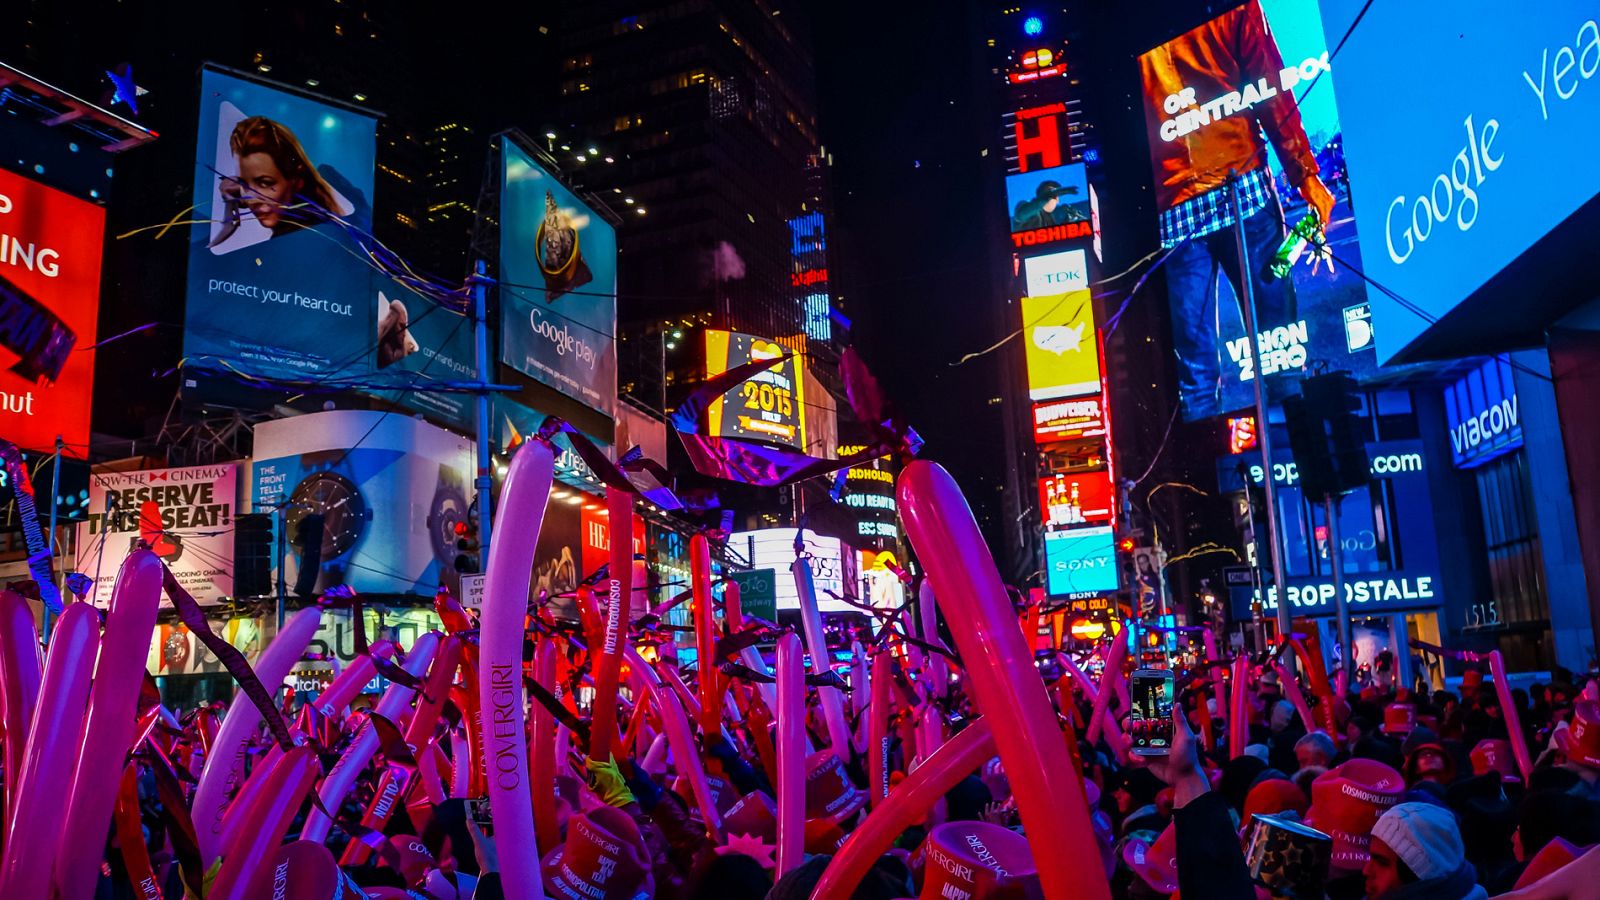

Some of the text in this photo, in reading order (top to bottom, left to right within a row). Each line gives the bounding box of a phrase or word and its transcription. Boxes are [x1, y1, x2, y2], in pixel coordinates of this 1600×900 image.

[1160, 78, 1277, 142] CENTRAL
[1164, 87, 1197, 115] OR
[1384, 114, 1505, 265] Google
[1011, 220, 1092, 247] TOSHIBA
[1044, 270, 1081, 284] TDK
[208, 279, 353, 316] protect your heart out
[530, 308, 598, 369] Google play
[1238, 344, 1307, 381] ZERO
[744, 381, 792, 417] 2015
[1035, 401, 1101, 425] BUDWEISER
[170, 467, 227, 482] CINEMAS
[260, 465, 276, 475] THE
[260, 473, 287, 485] FRONT
[105, 482, 214, 512] RESERVE
[260, 484, 283, 495] TELLS
[260, 495, 275, 505] THE
[845, 494, 865, 507] YOU
[161, 503, 230, 531] SEAT!
[1056, 557, 1108, 572] SONY
[473, 578, 485, 586] CIT
[1069, 590, 1098, 600] SONY
[604, 580, 620, 655] COSMOPOLITAN
[1464, 600, 1498, 626] 1515
[491, 655, 520, 793] COVERGIRL
[941, 882, 972, 900] HAPPY
